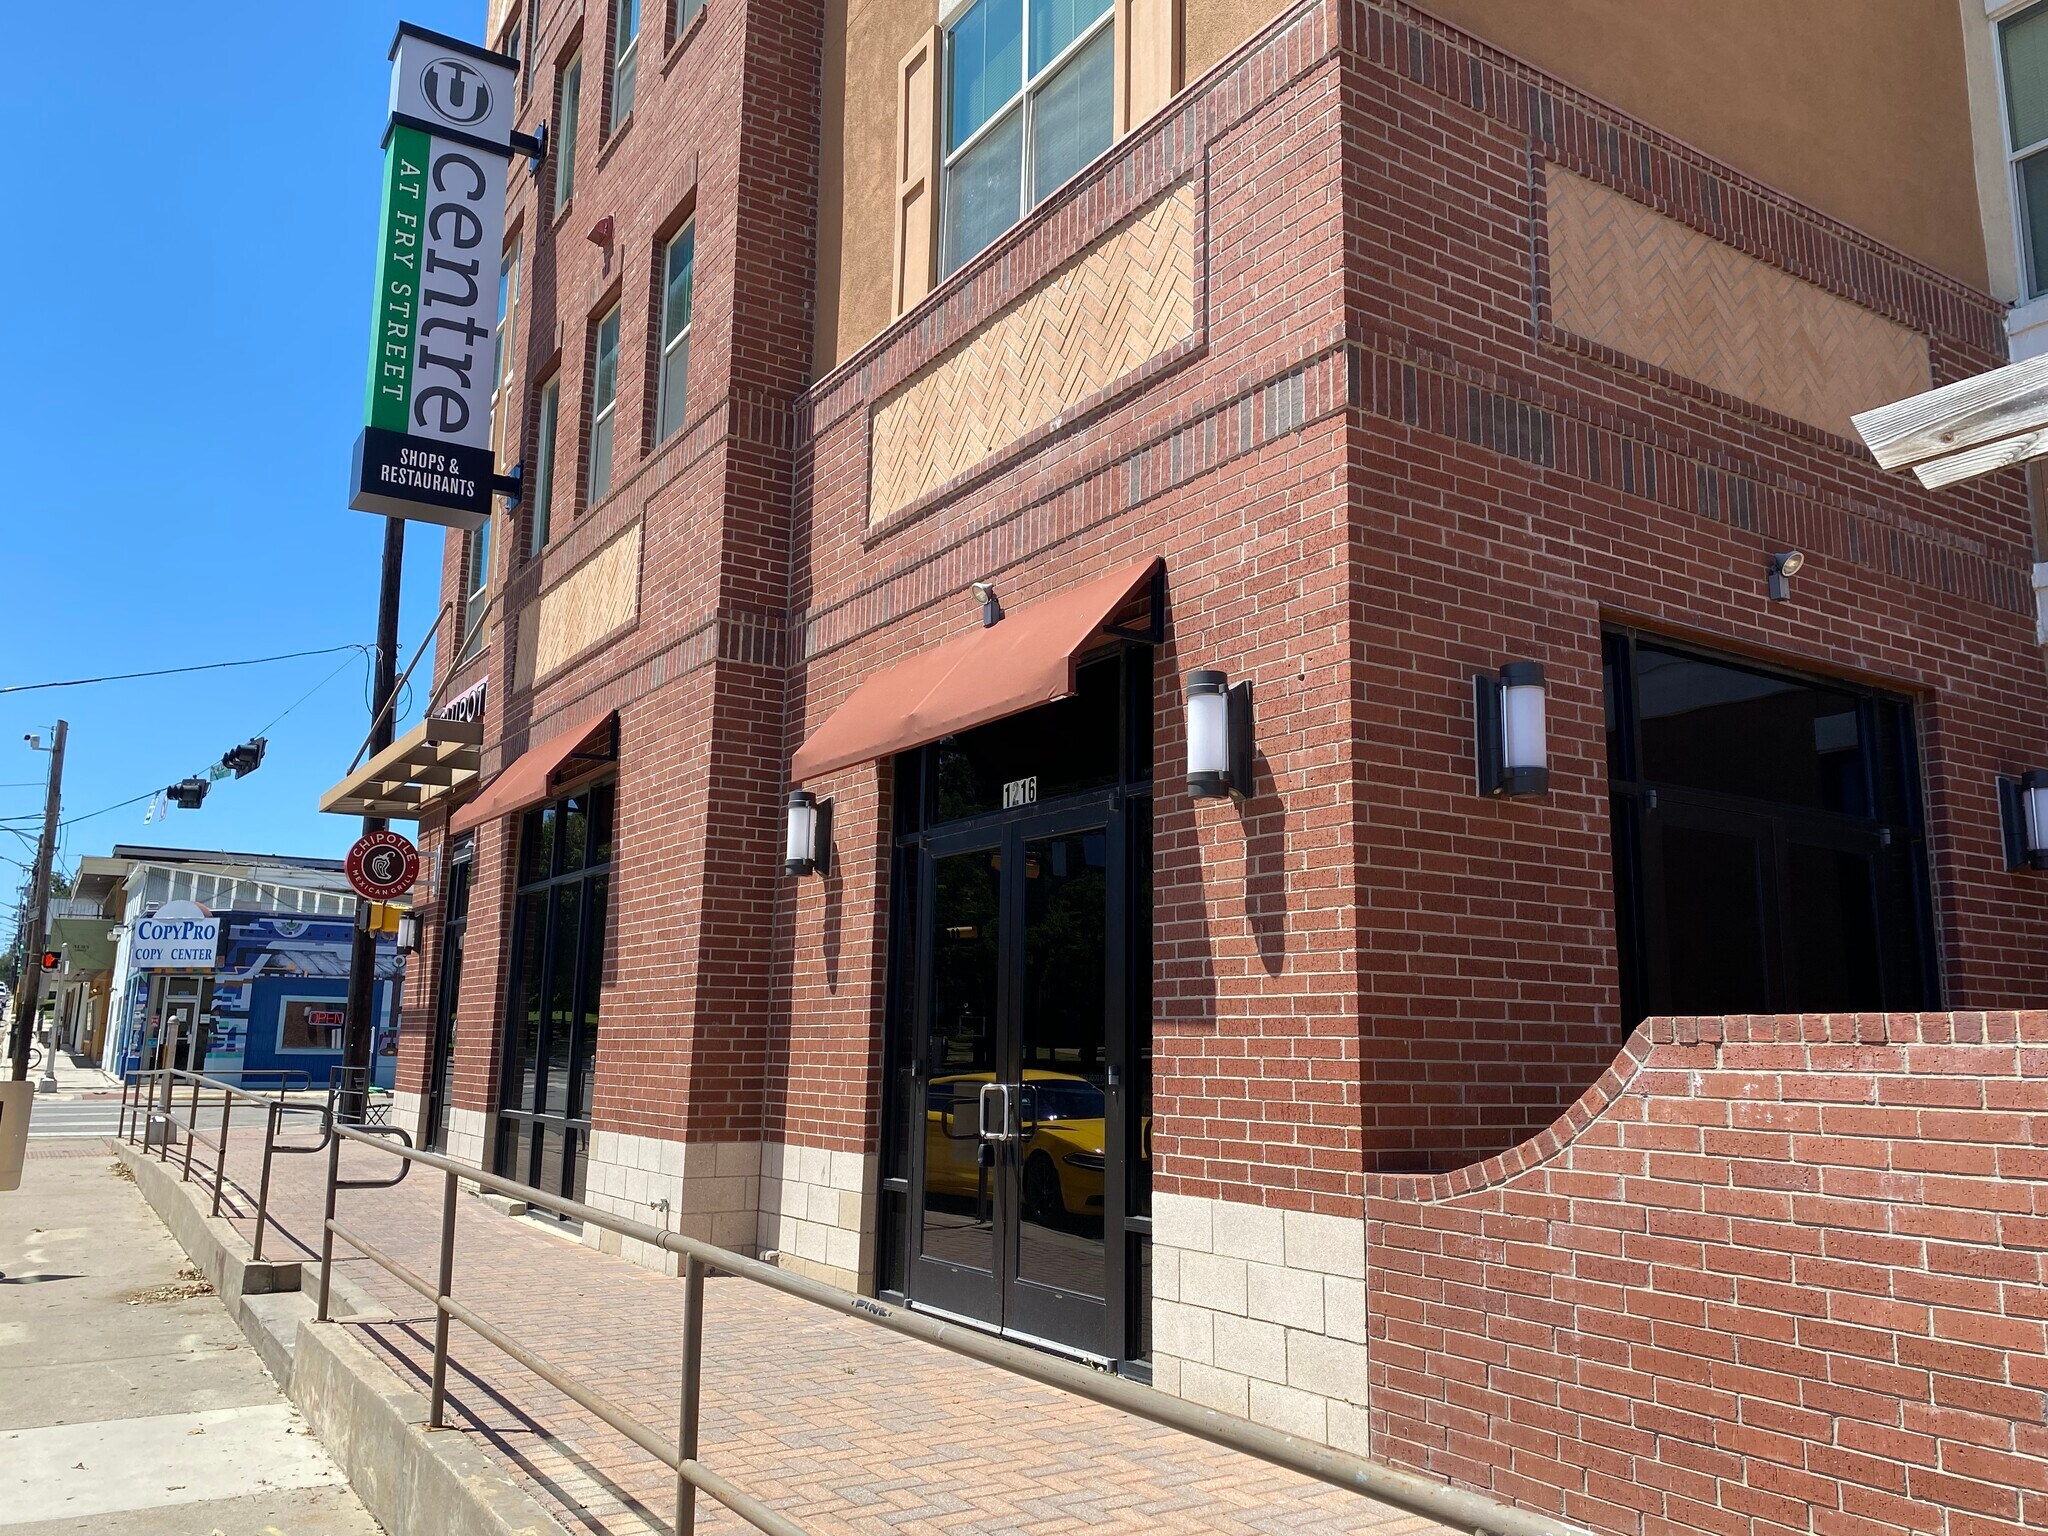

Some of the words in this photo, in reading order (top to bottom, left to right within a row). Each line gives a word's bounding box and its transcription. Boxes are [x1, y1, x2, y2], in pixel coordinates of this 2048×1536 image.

[400, 158, 421, 200] AT
[393, 210, 418, 269] FRY
[413, 152, 489, 434] centre
[382, 280, 412, 401] STREET
[400, 448, 445, 472] SHOPS
[449, 458, 460, 475] &
[380, 464, 476, 498] RESTAURANTS
[1004, 777, 1036, 808] 1216
[352, 833, 417, 862] CHIPOTLE
[352, 869, 388, 895] MEXICAN
[390, 873, 414, 894] GRILL
[135, 948, 163, 960] COPY
[170, 948, 212, 960] CENTER
